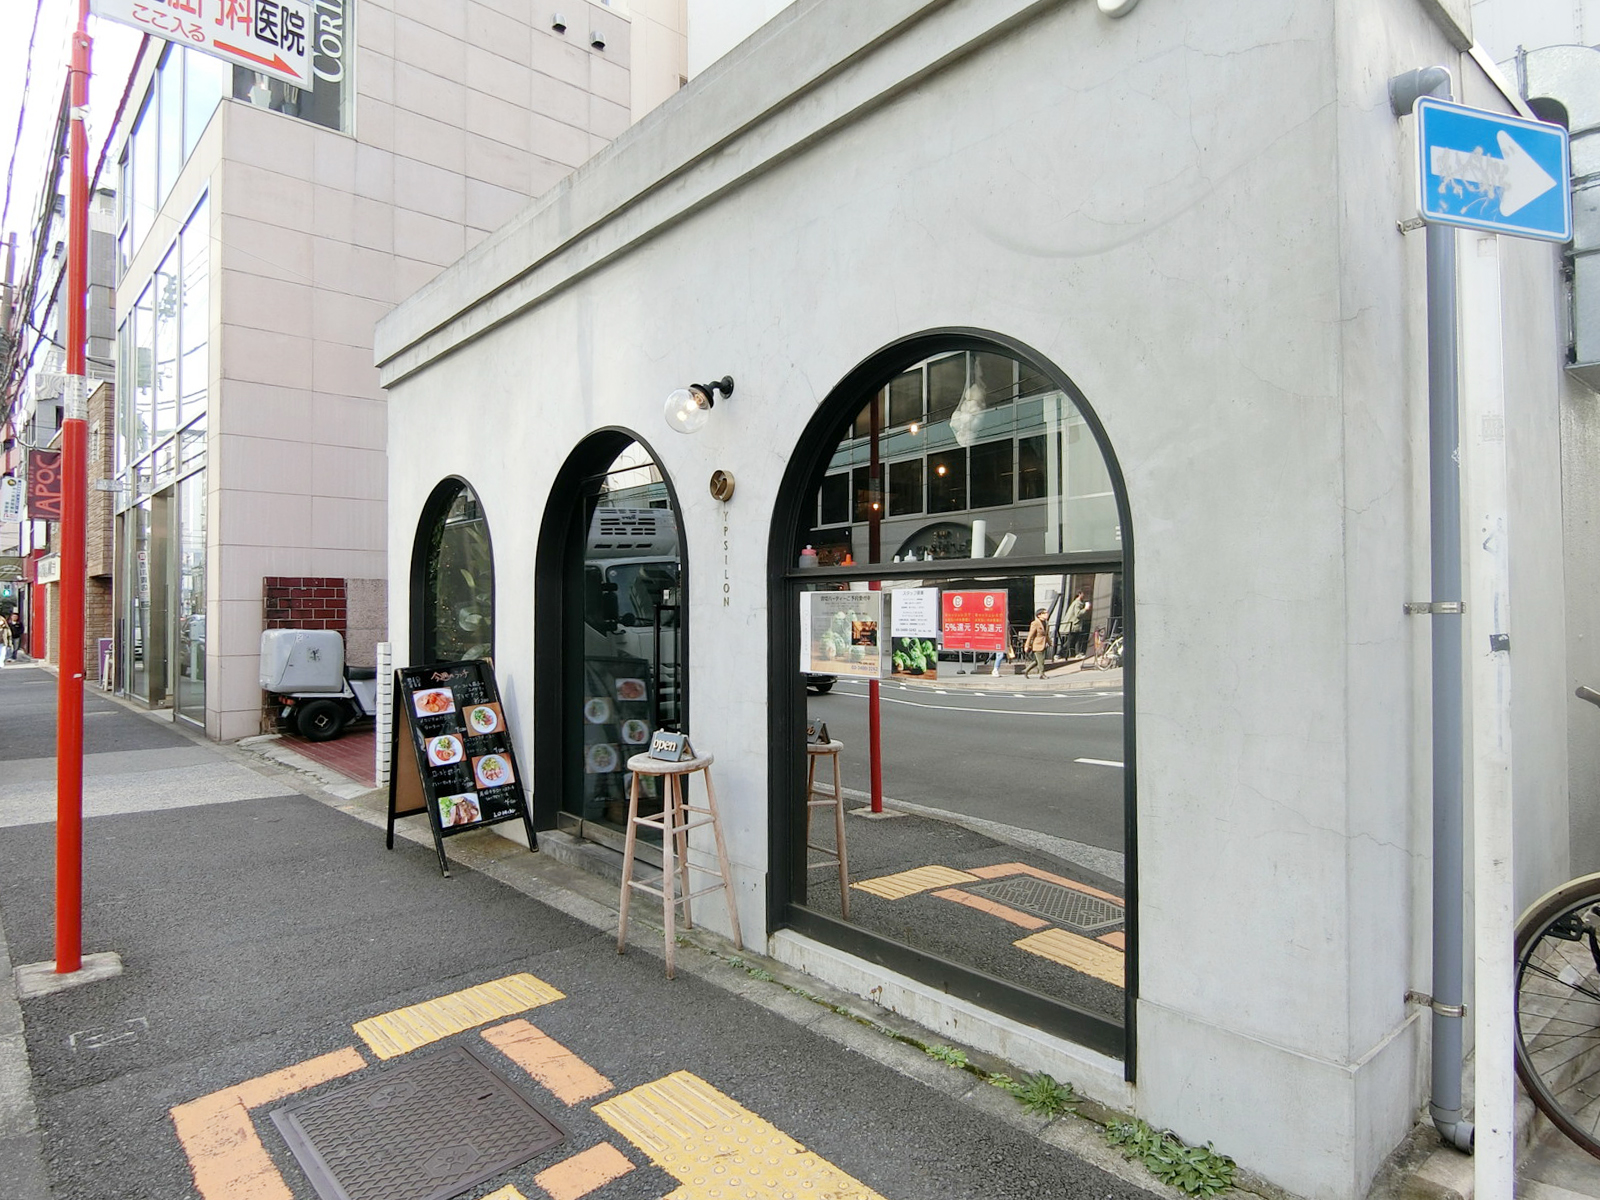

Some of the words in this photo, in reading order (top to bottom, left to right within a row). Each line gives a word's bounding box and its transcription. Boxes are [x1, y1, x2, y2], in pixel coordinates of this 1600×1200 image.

[132, 3, 206, 43] ここ入る
[944, 623, 971, 632] 5%還元
[974, 623, 1003, 633] 5%還元
[653, 739, 677, 752] open
